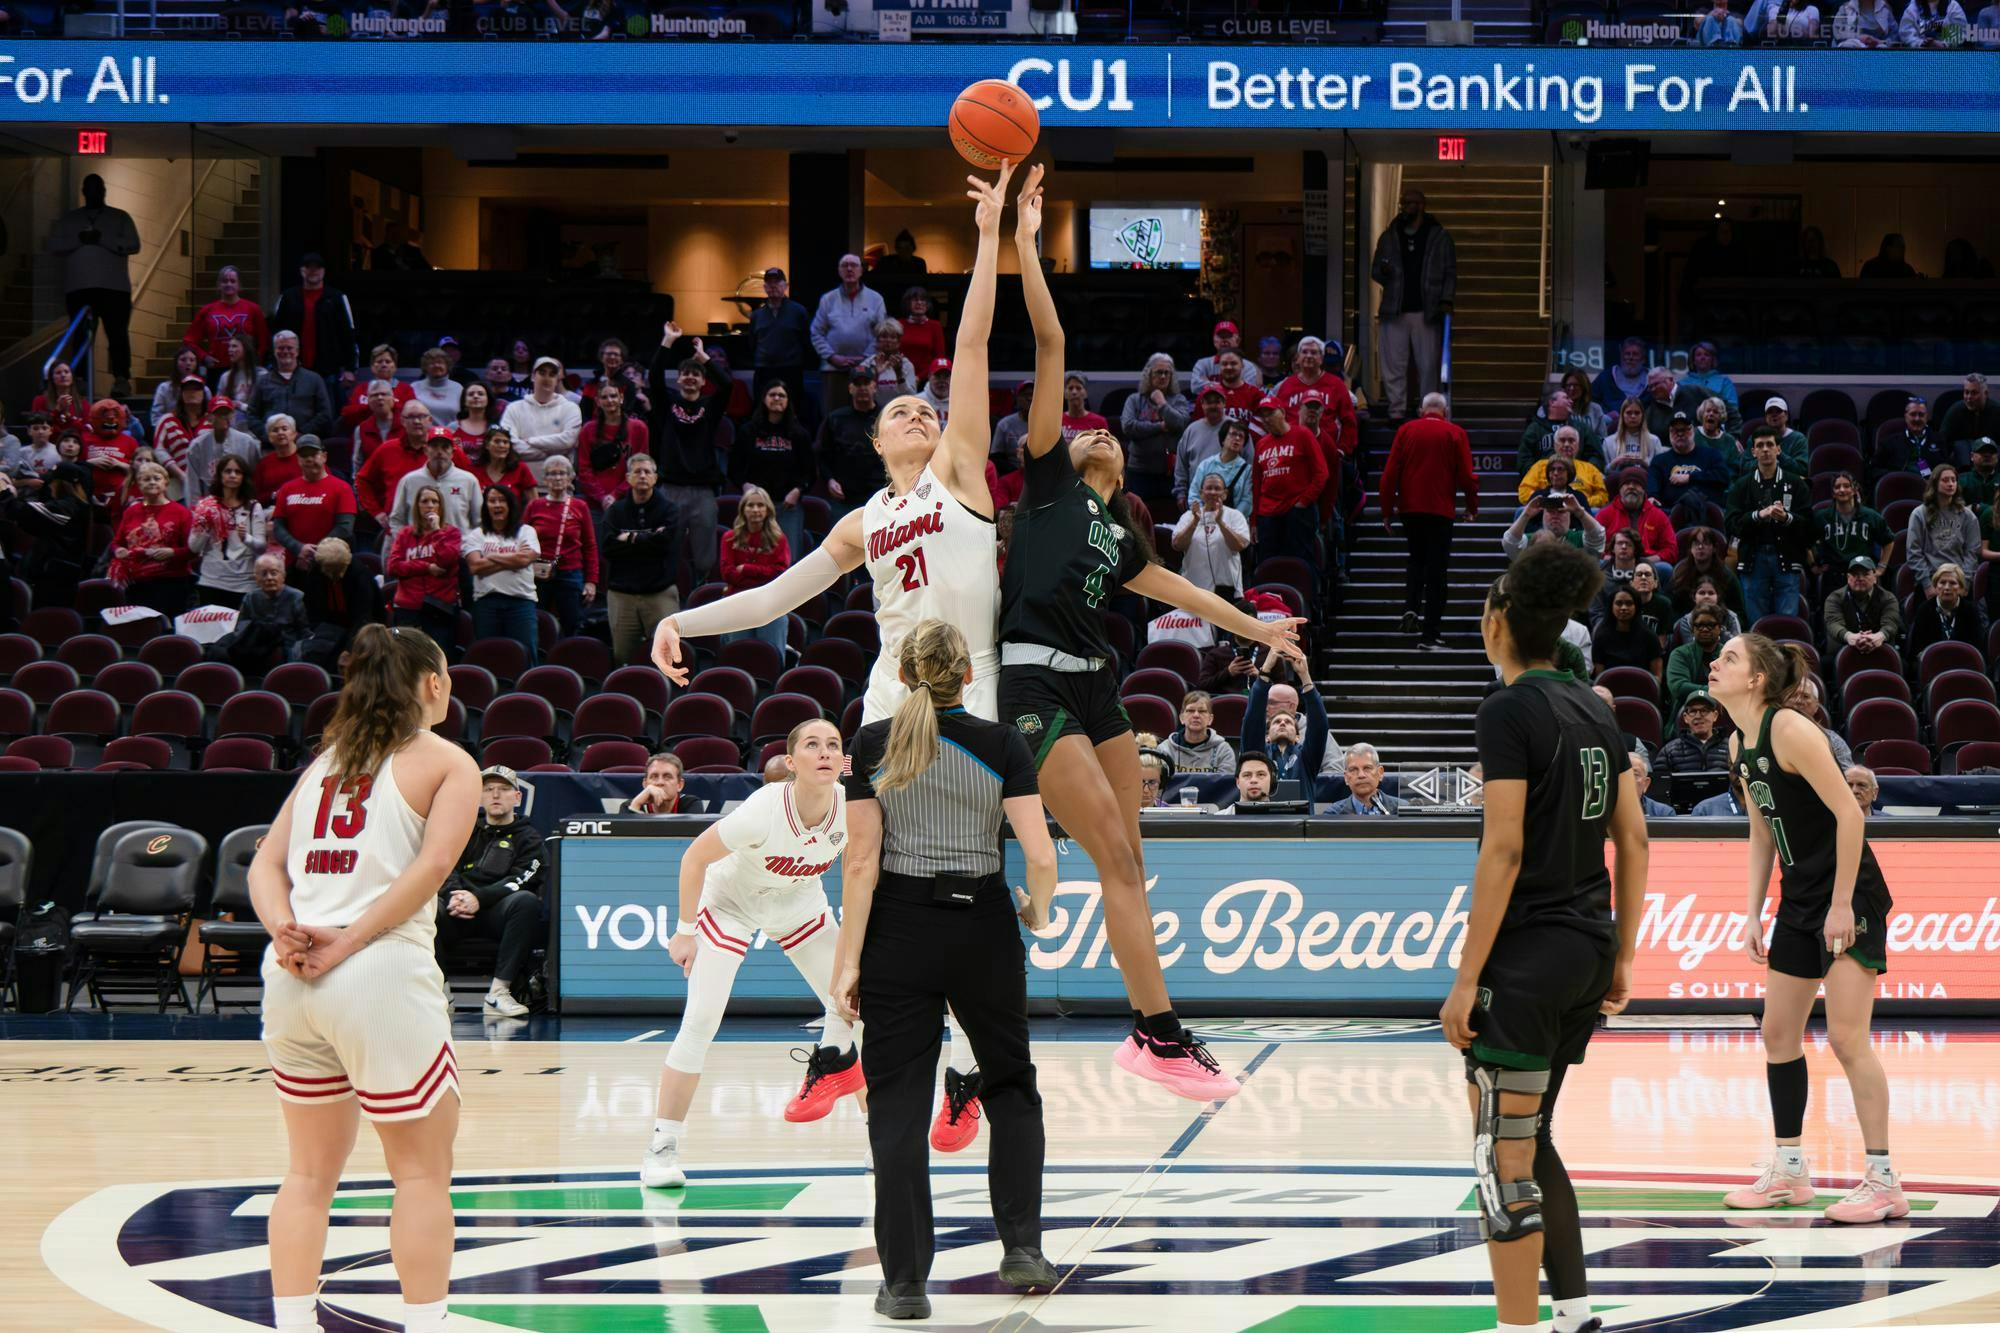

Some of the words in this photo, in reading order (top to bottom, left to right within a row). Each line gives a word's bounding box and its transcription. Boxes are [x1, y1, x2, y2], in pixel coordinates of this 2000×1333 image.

[351, 12, 447, 37] Huntington
[475, 16, 527, 32] CLUB
[651, 14, 747, 38] Huntington
[914, 15, 936, 25] AM
[946, 15, 978, 26] 106.9
[981, 15, 1000, 26] FM
[1222, 20, 1272, 35] CLUB
[1278, 20, 1336, 35] LEVEL
[1586, 20, 1680, 41] Huntington
[86, 56, 169, 104] All.
[1007, 58, 1133, 112] CU1
[1207, 61, 1372, 111] Better
[1389, 62, 1602, 123] Banking
[1625, 64, 1713, 112] For
[1727, 65, 1809, 113] All.
[78, 131, 107, 153] EXIT
[1438, 138, 1466, 160] EXIT
[1258, 445, 1295, 463] MIAMI
[1473, 455, 1503, 470] 108
[286, 493, 327, 505] Miami
[868, 501, 944, 562] Miami
[895, 546, 928, 593] 21
[1083, 563, 1110, 608] 4
[184, 609, 235, 624] Miami
[1580, 747, 1609, 820] 13
[313, 773, 374, 839] 13
[566, 821, 612, 835] anc
[763, 855, 835, 877] Miam
[1029, 875, 1187, 970] Te
[1200, 879, 1470, 974] Beach
[1886, 897, 2000, 952] each
